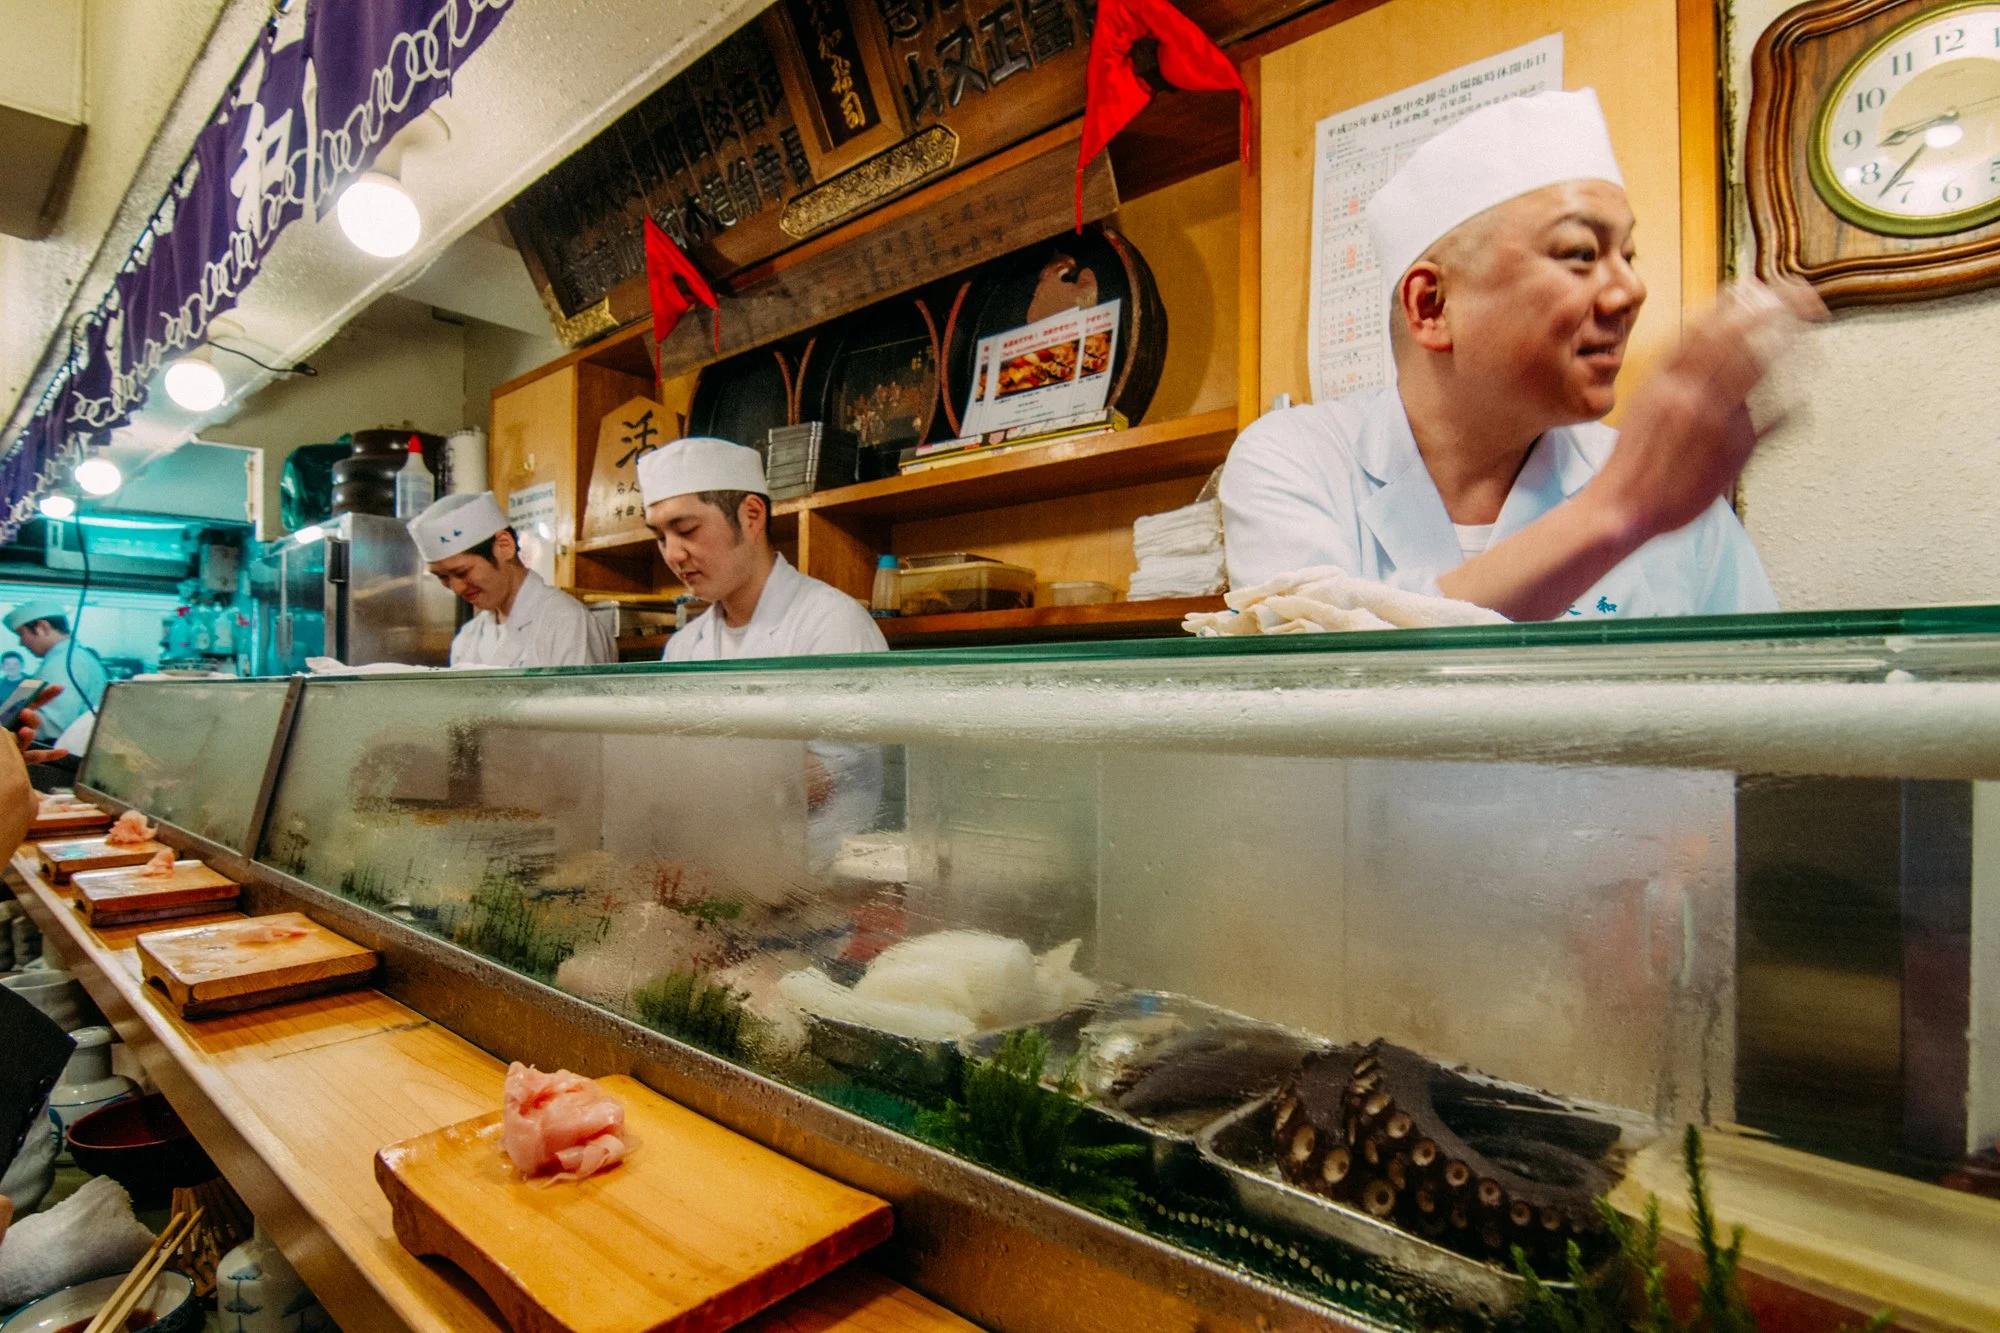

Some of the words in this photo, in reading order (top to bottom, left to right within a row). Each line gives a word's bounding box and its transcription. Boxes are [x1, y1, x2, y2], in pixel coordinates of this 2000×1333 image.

[1935, 29, 1965, 55] 12
[1892, 51, 1913, 76] 11
[1856, 87, 1885, 113] 10
[1843, 130, 1862, 152] 9
[1861, 162, 1881, 185] 8
[1897, 181, 1914, 204] 7
[1942, 182, 1962, 203] 6
